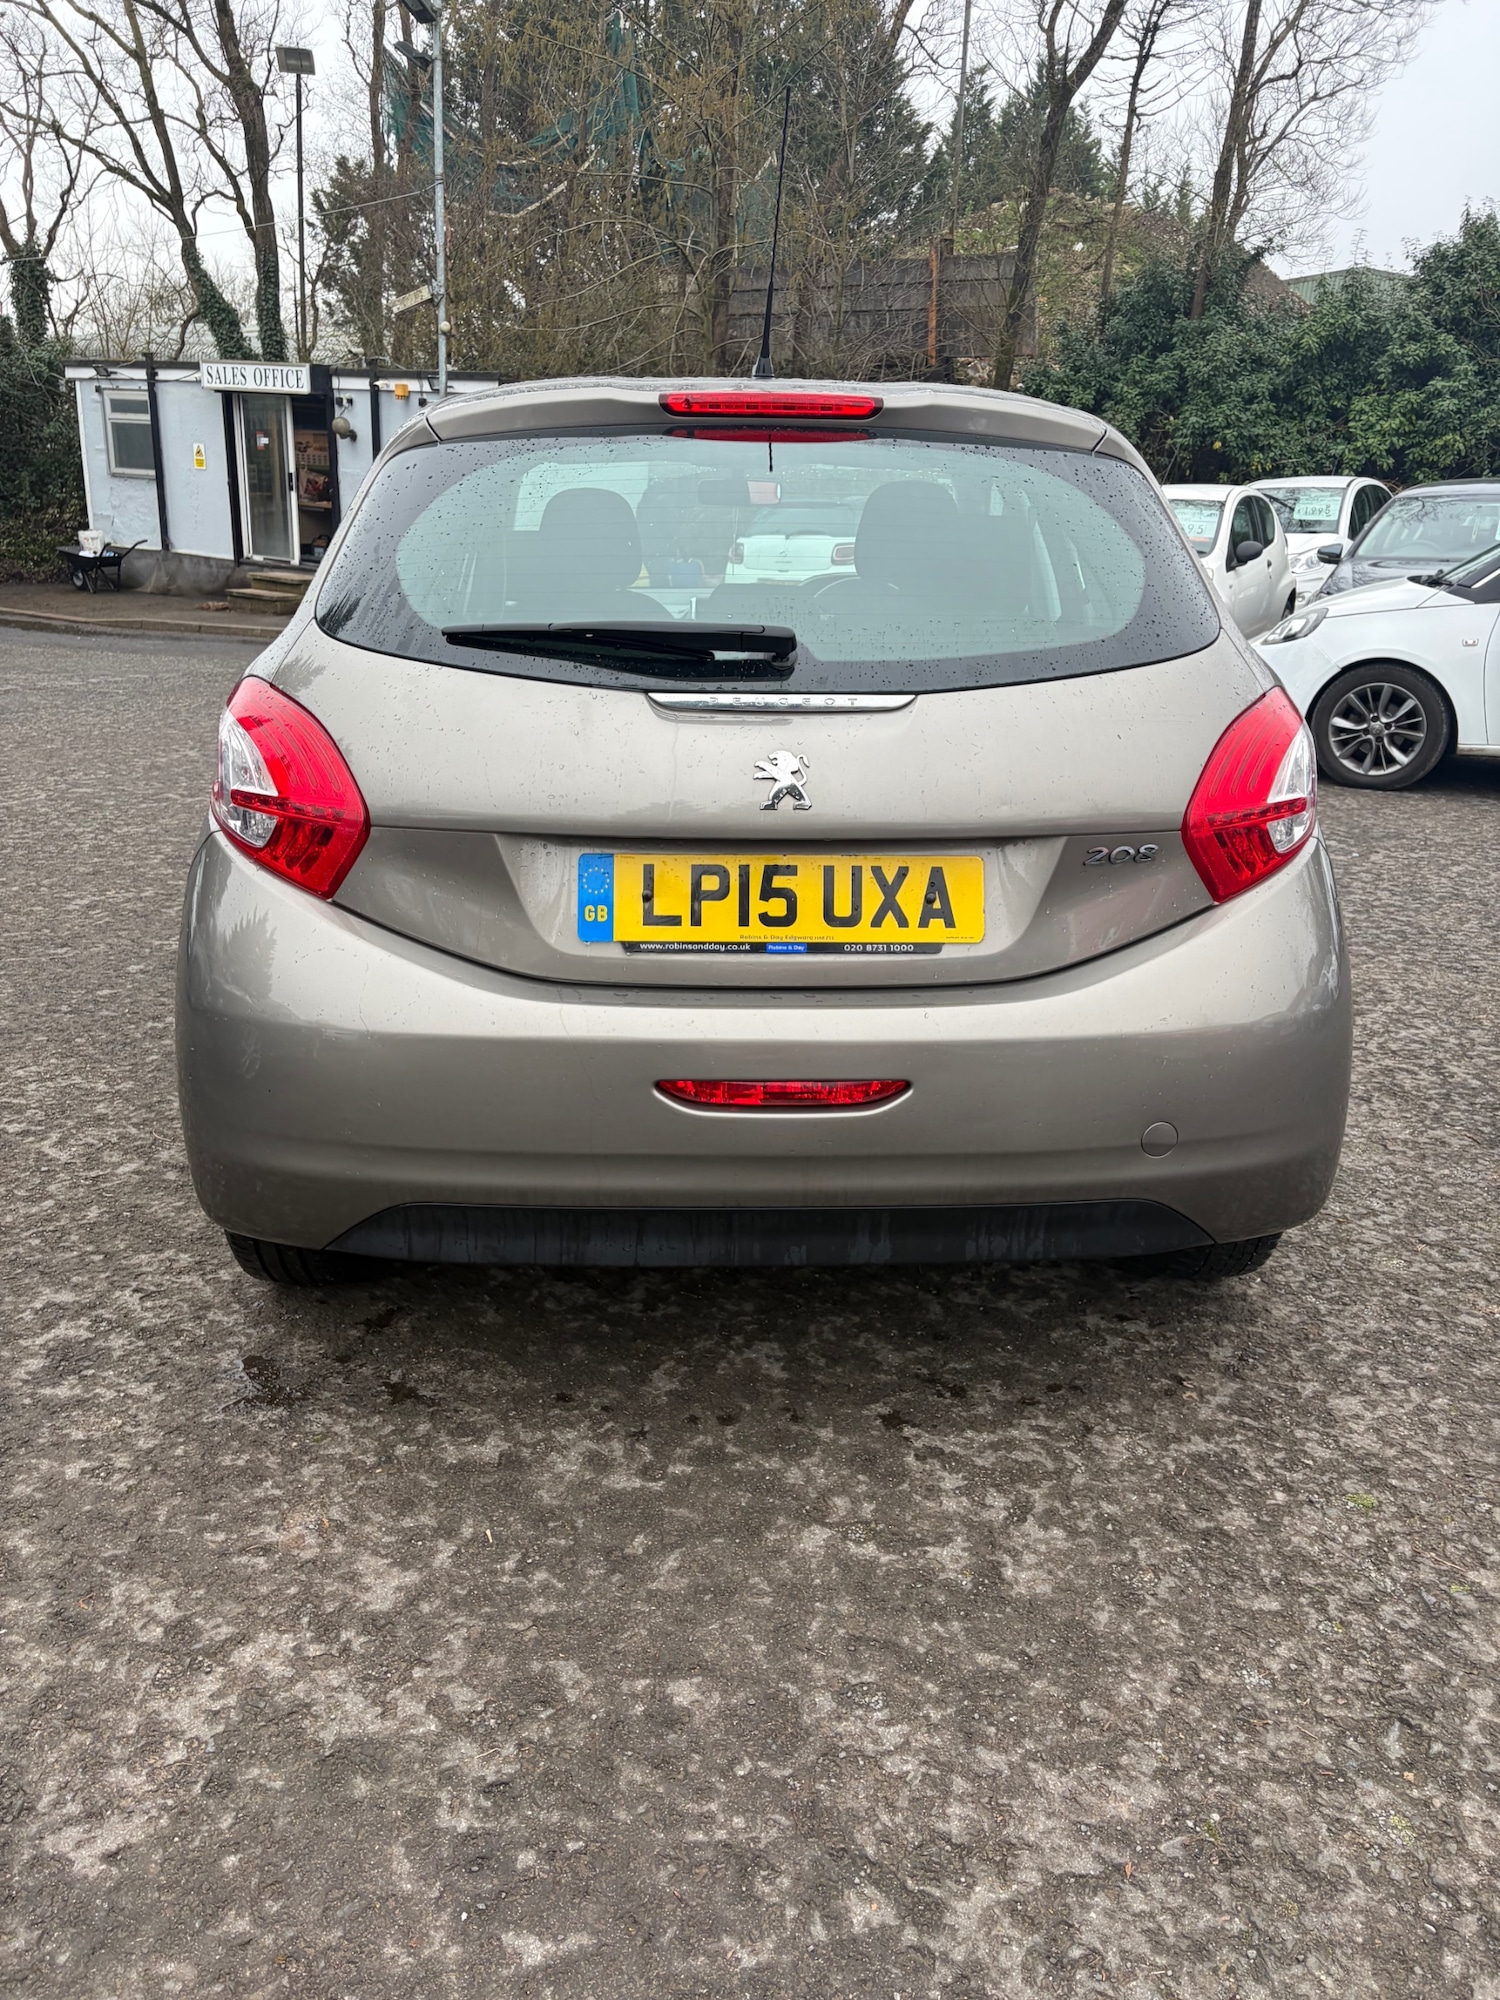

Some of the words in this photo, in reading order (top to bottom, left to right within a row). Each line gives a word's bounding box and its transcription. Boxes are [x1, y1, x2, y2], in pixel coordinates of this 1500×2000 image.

[206, 365, 247, 386] SALES
[253, 366, 304, 389] OFFICE
[708, 696, 858, 707] PEUGEOT
[1083, 843, 1160, 865] 208
[642, 863, 798, 928] LP15
[823, 865, 957, 929] UXA
[583, 905, 608, 922] GB
[639, 942, 751, 952] www.robinsandday.co.uk
[843, 944, 863, 952] 020
[866, 944, 887, 952] 8731
[889, 944, 914, 952] 1000
